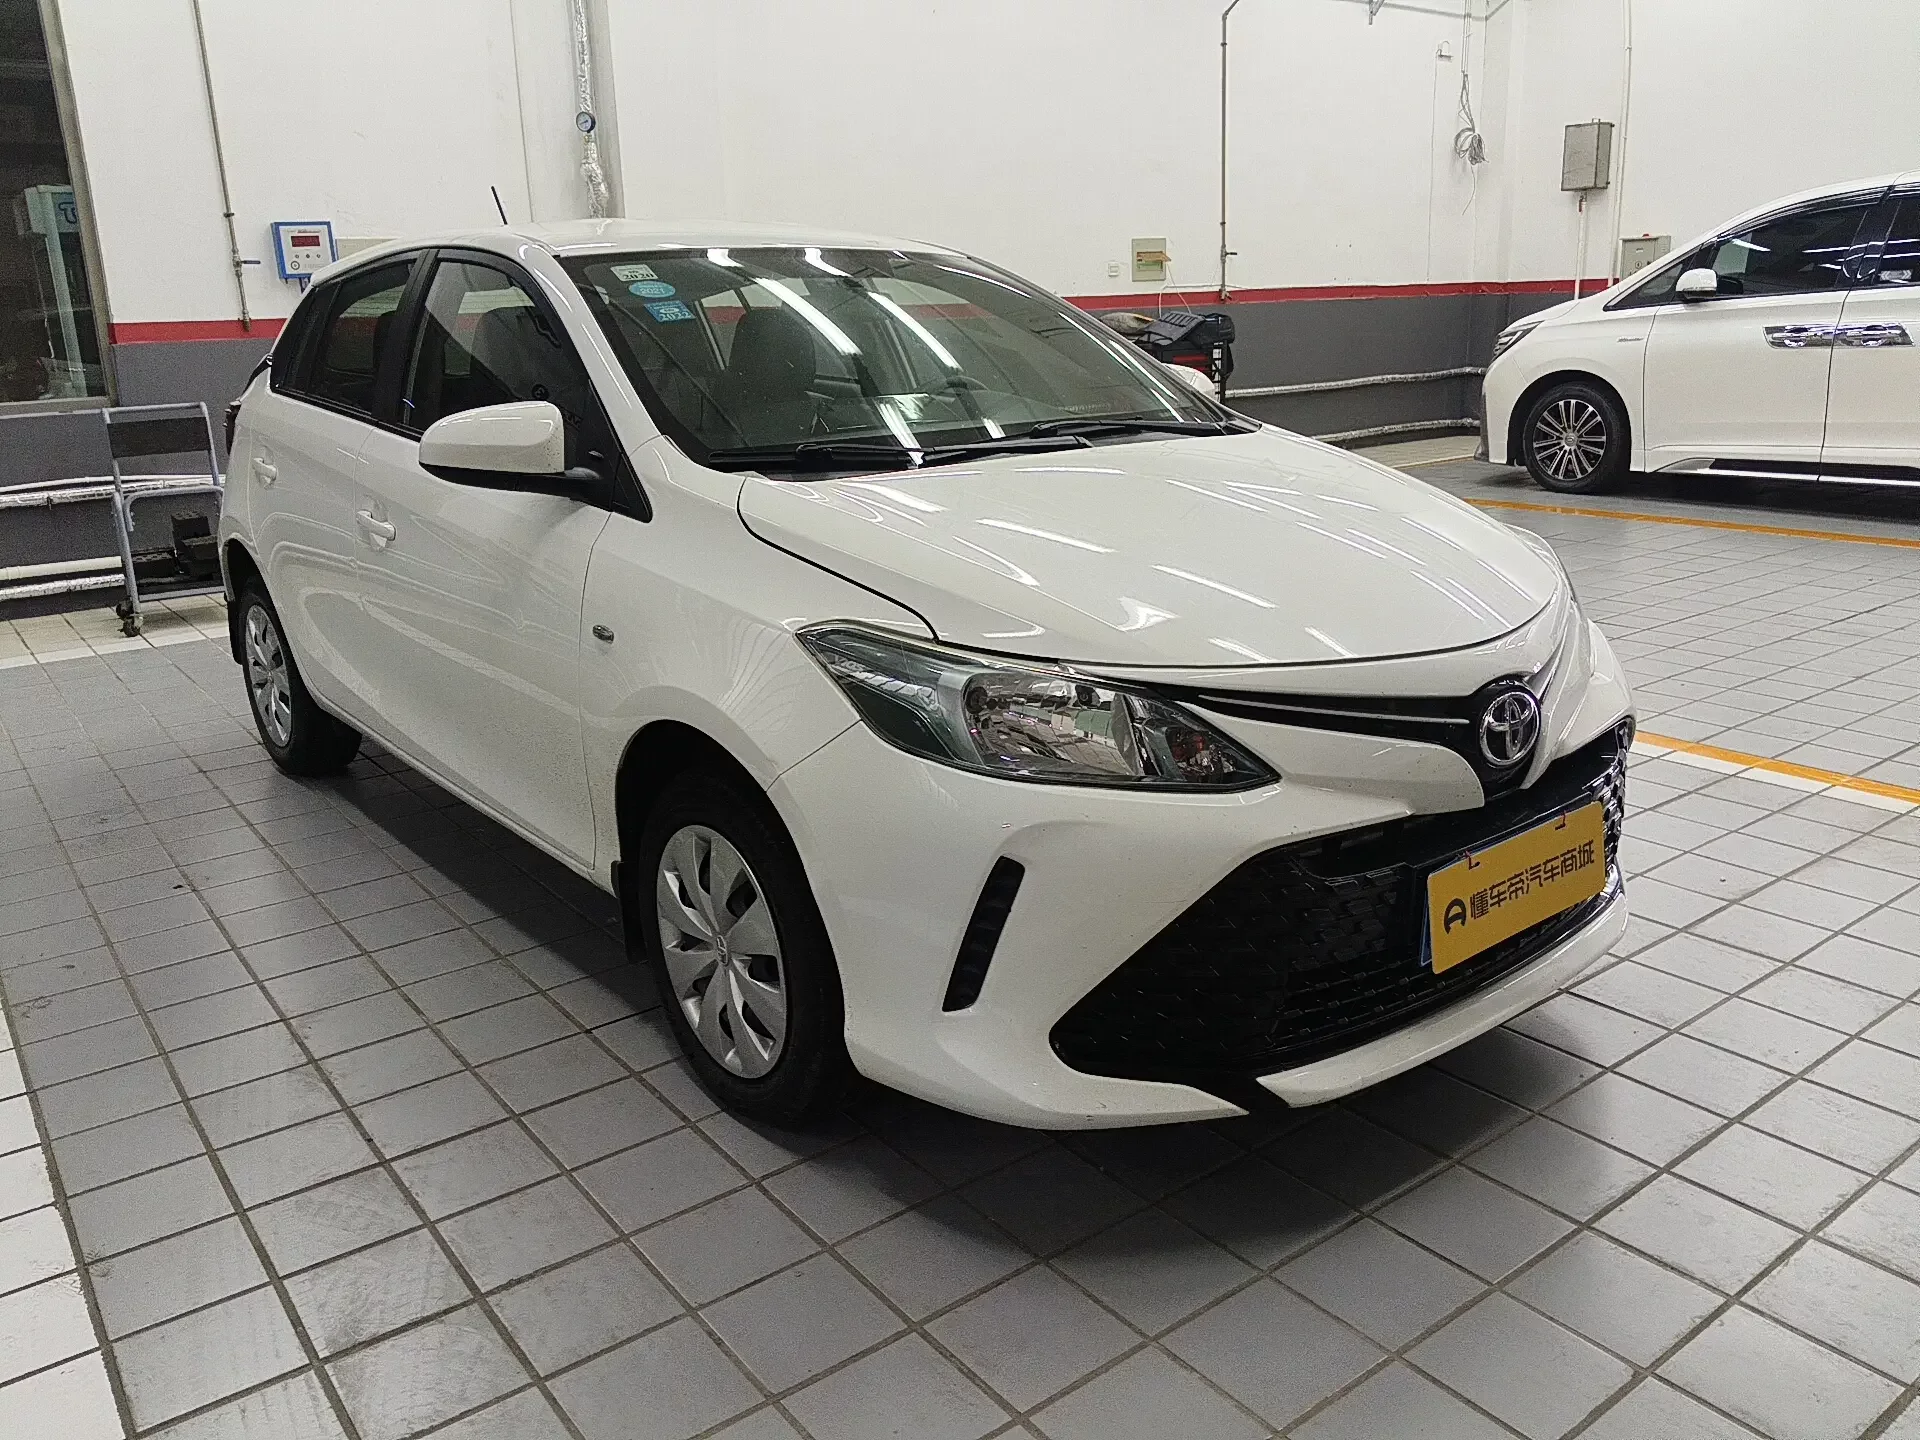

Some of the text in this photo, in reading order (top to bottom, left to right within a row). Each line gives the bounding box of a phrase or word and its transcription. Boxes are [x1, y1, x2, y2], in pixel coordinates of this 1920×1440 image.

[659, 312, 692, 320] 2022
[1469, 839, 1595, 920] 懂车帝汽车商城
